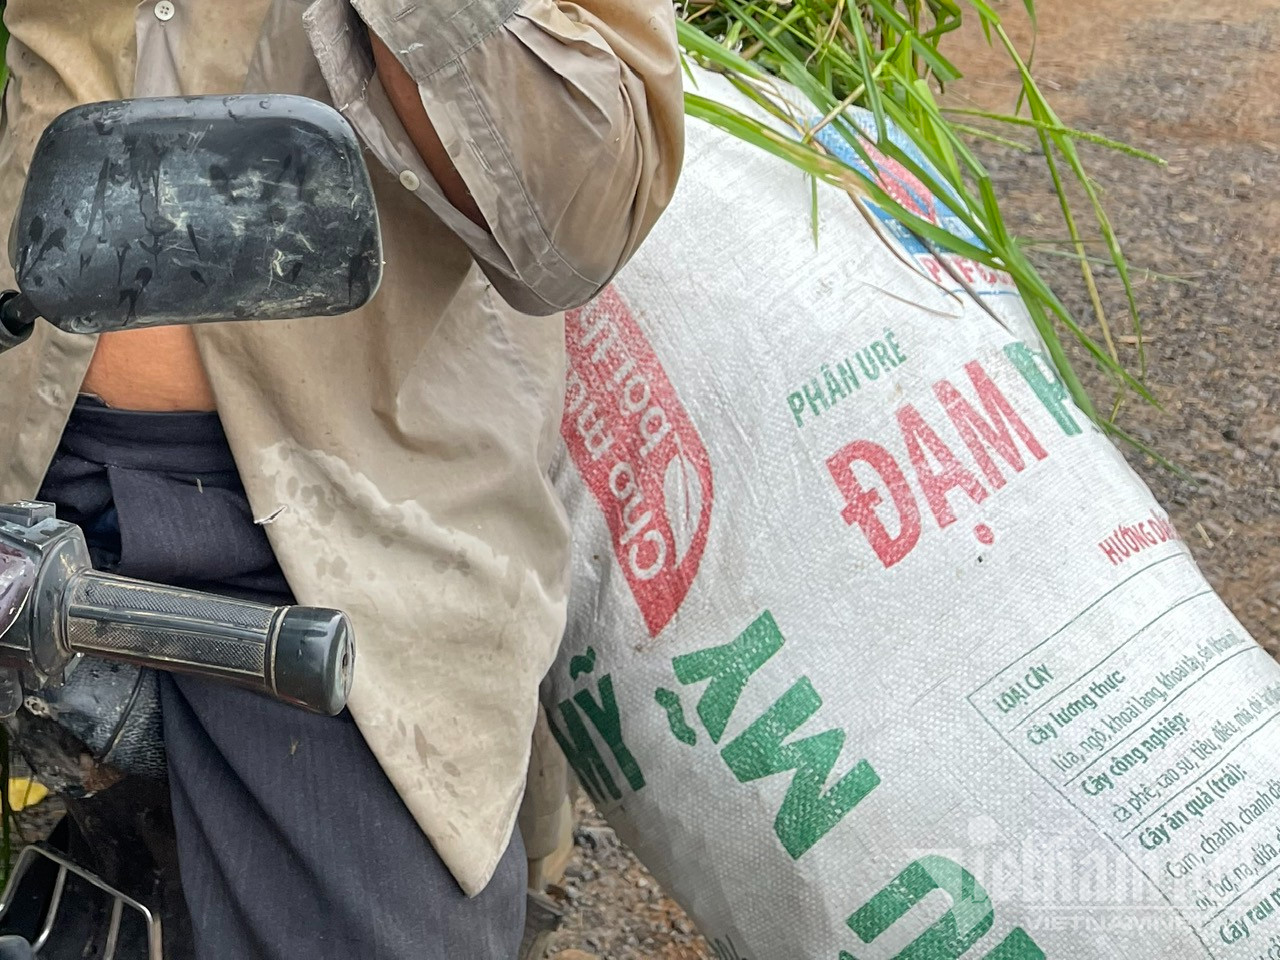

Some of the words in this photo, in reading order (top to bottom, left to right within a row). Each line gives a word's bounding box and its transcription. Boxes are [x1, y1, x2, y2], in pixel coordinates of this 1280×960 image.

[787, 359, 859, 428] PHÂN
[854, 326, 908, 382] URÊ
[825, 359, 1049, 569] ĐẠM
[608, 460, 667, 580] Cho
[992, 682, 1031, 713] LOẠI
[1024, 663, 1054, 690] CÂY
[1027, 722, 1058, 745] Cây
[1049, 694, 1097, 727] lương
[1089, 671, 1126, 698] thực
[1050, 752, 1086, 772] lúa,
[1079, 728, 1112, 753] ngô,
[1101, 697, 1142, 734] khoai
[1132, 677, 1168, 710] lang,
[1156, 660, 1189, 696] khoai
[653, 609, 881, 861] MỸ
[1080, 772, 1114, 796] Cây
[1110, 747, 1148, 776] công
[1140, 713, 1190, 752] nghiệp:
[1127, 784, 1161, 812] phê,
[1156, 769, 1180, 788] cao
[1190, 738, 1222, 760] tiêu,
[1139, 824, 1171, 850] Cây
[1162, 810, 1189, 830] ăn
[1185, 787, 1215, 817] quả
[1206, 763, 1247, 798] (trái):
[1164, 852, 1205, 879] Cam,
[1201, 819, 1244, 854] chanh,
[1238, 791, 1274, 825] chanh
[1233, 863, 1258, 881] na,
[1246, 898, 1275, 925] rau
